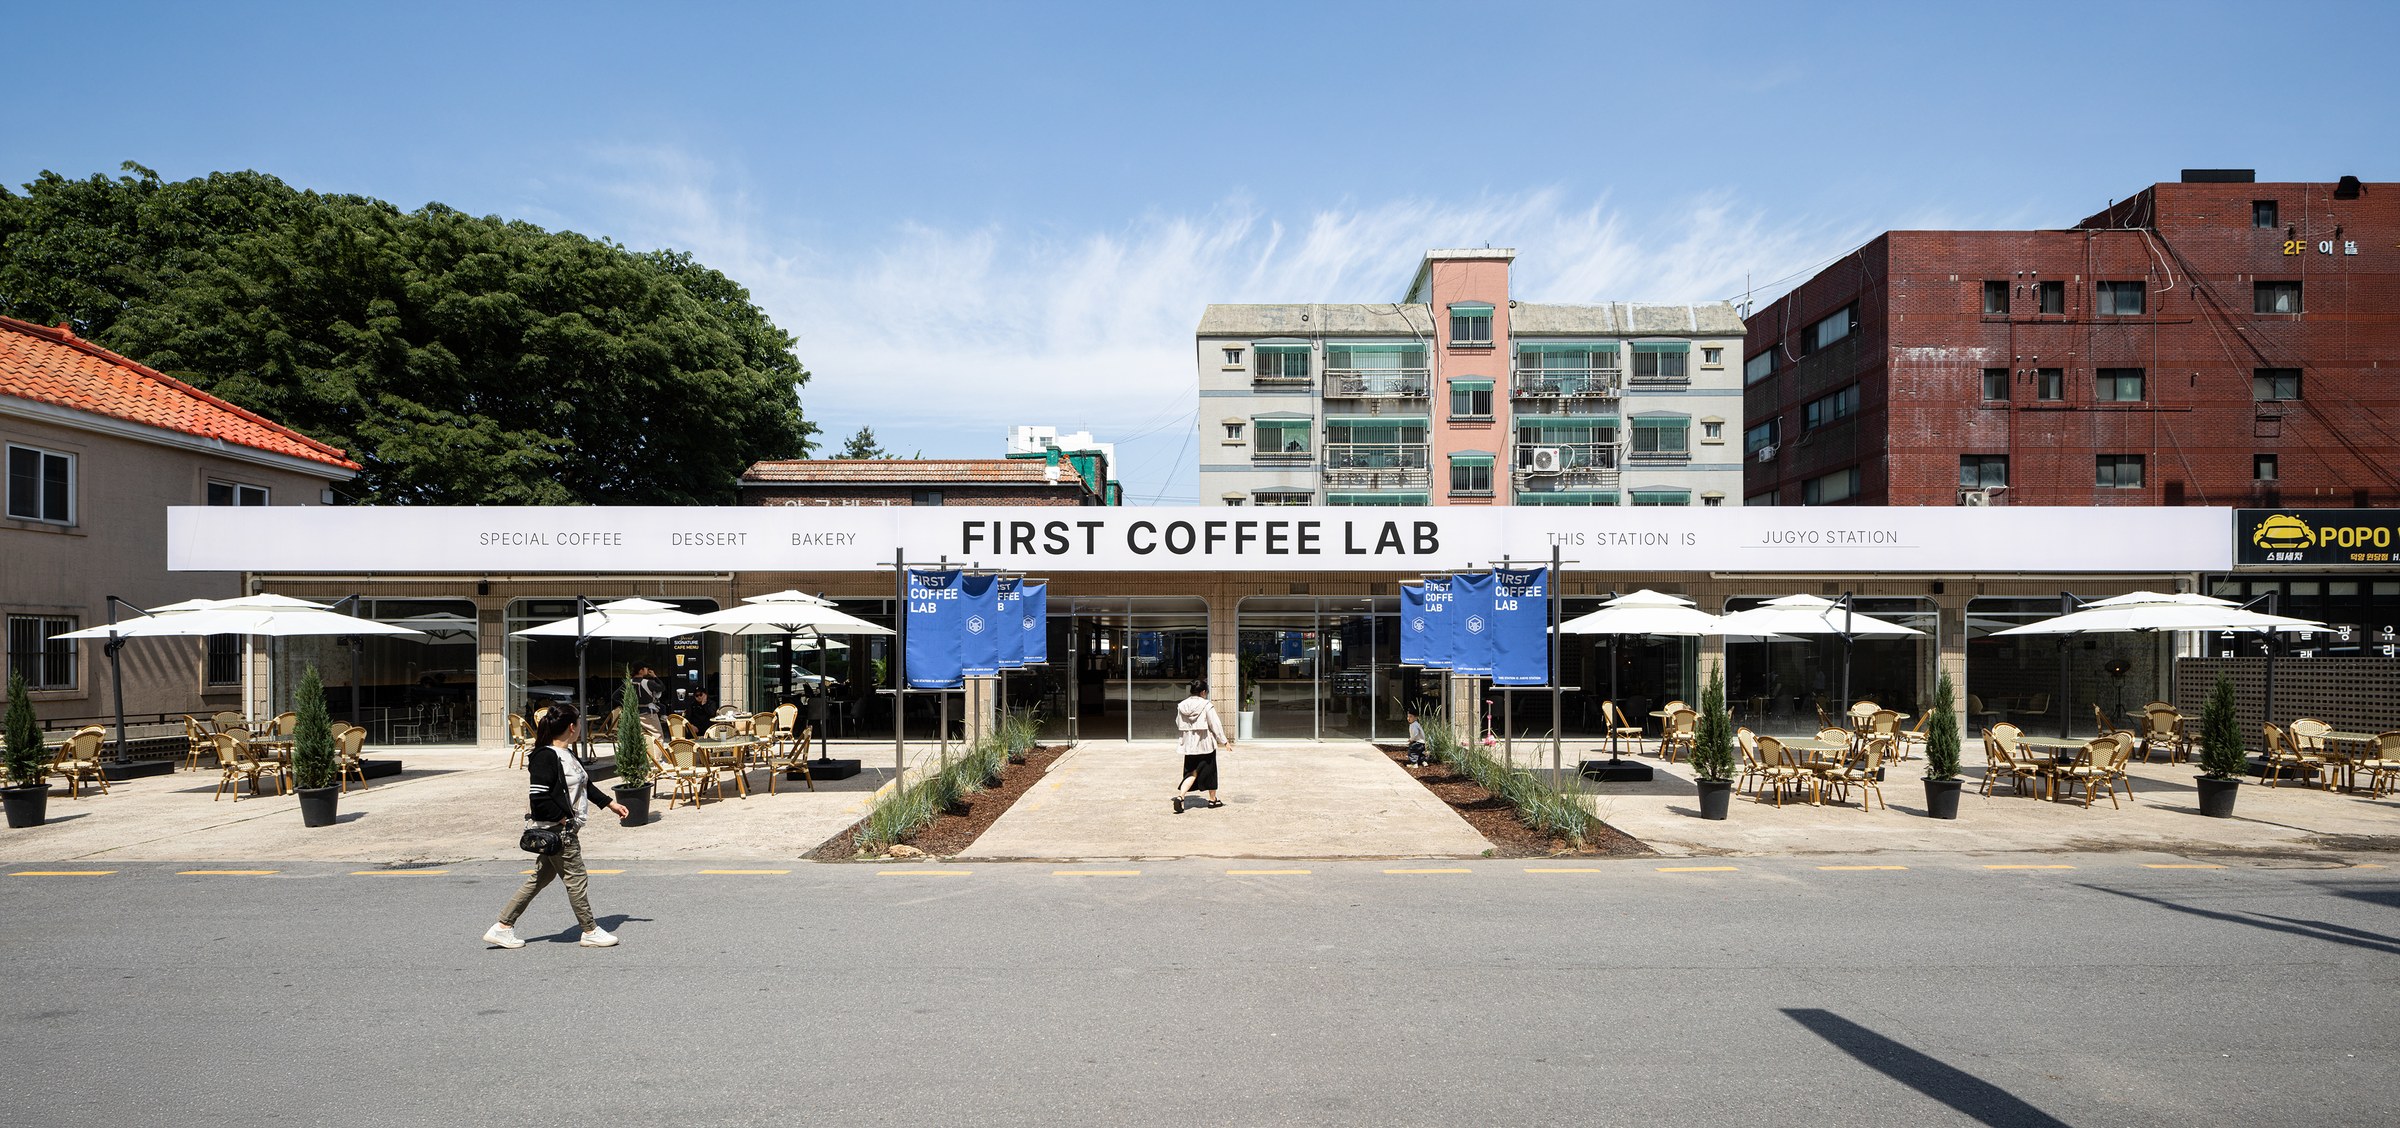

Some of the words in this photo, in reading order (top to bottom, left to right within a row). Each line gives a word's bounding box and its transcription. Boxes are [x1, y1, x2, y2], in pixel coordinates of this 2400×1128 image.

[479, 532, 550, 546] SPECIAL
[556, 532, 622, 546] COFFEE
[672, 532, 748, 546] DESSERT
[791, 532, 856, 546] BAKERY
[961, 520, 1105, 555] FIRST
[1126, 520, 1321, 555] COFFEE
[1345, 521, 1440, 555] LAB
[1546, 532, 1585, 546] THIS
[1597, 532, 1669, 546] STATION
[1681, 532, 1696, 546] IS
[1762, 530, 1819, 544] JUGYO
[1826, 530, 1897, 544] STATION
[2320, 526, 2390, 548] POPO
[910, 574, 946, 587] FIRST
[1495, 572, 1530, 585] FIRST
[1425, 582, 1451, 592] FIRST
[1495, 585, 1542, 598] COFFEE
[910, 588, 959, 600] COFFEE
[1425, 592, 1453, 602] COFFE
[910, 601, 937, 614] LAB
[1425, 603, 1443, 613] LAB
[1495, 599, 1518, 611] LAB
